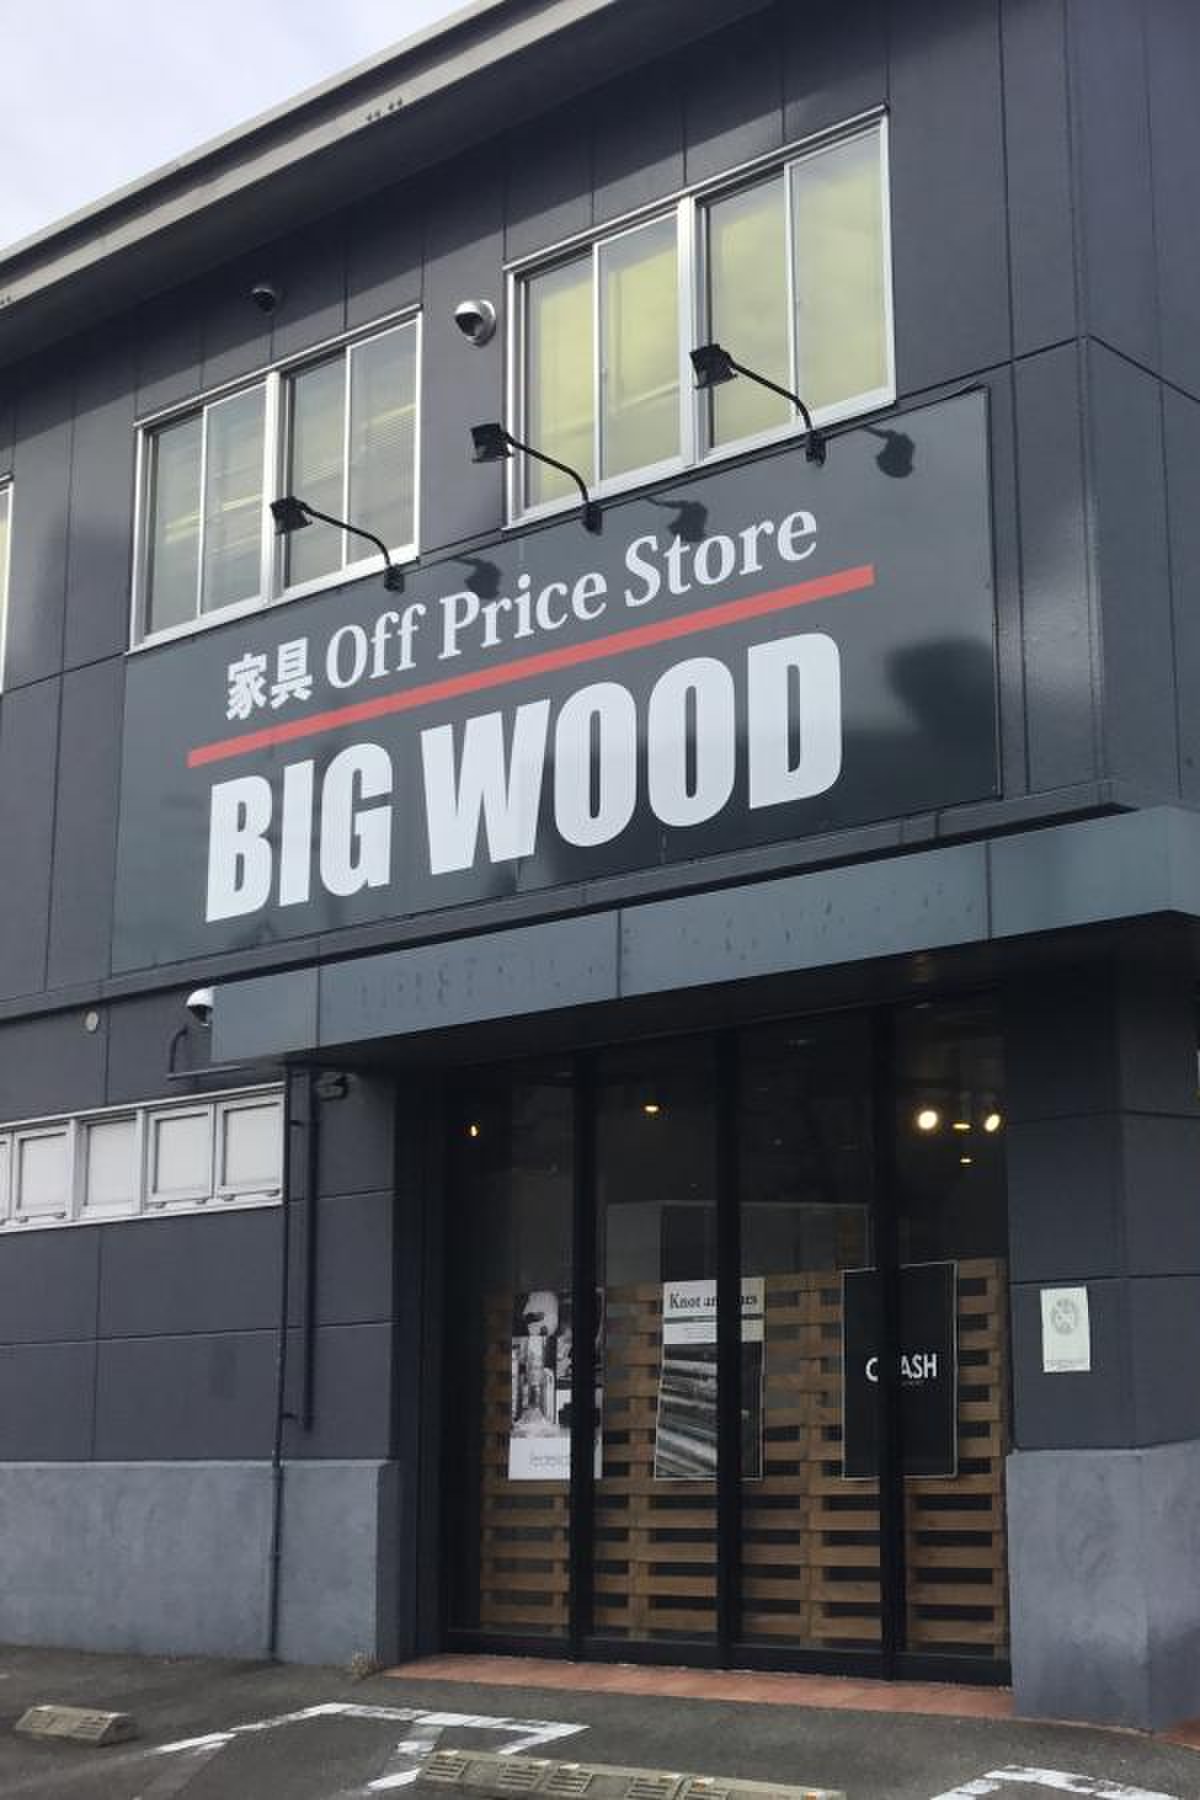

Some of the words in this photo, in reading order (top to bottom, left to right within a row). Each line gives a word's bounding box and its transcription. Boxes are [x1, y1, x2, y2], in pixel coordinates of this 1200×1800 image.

[225, 638, 313, 721] 家具
[325, 604, 427, 690] Off
[438, 572, 608, 661] Price
[623, 510, 819, 608] Store
[205, 742, 394, 923] BIG
[420, 632, 844, 876] WOOD
[865, 1352, 938, 1383] CASH
